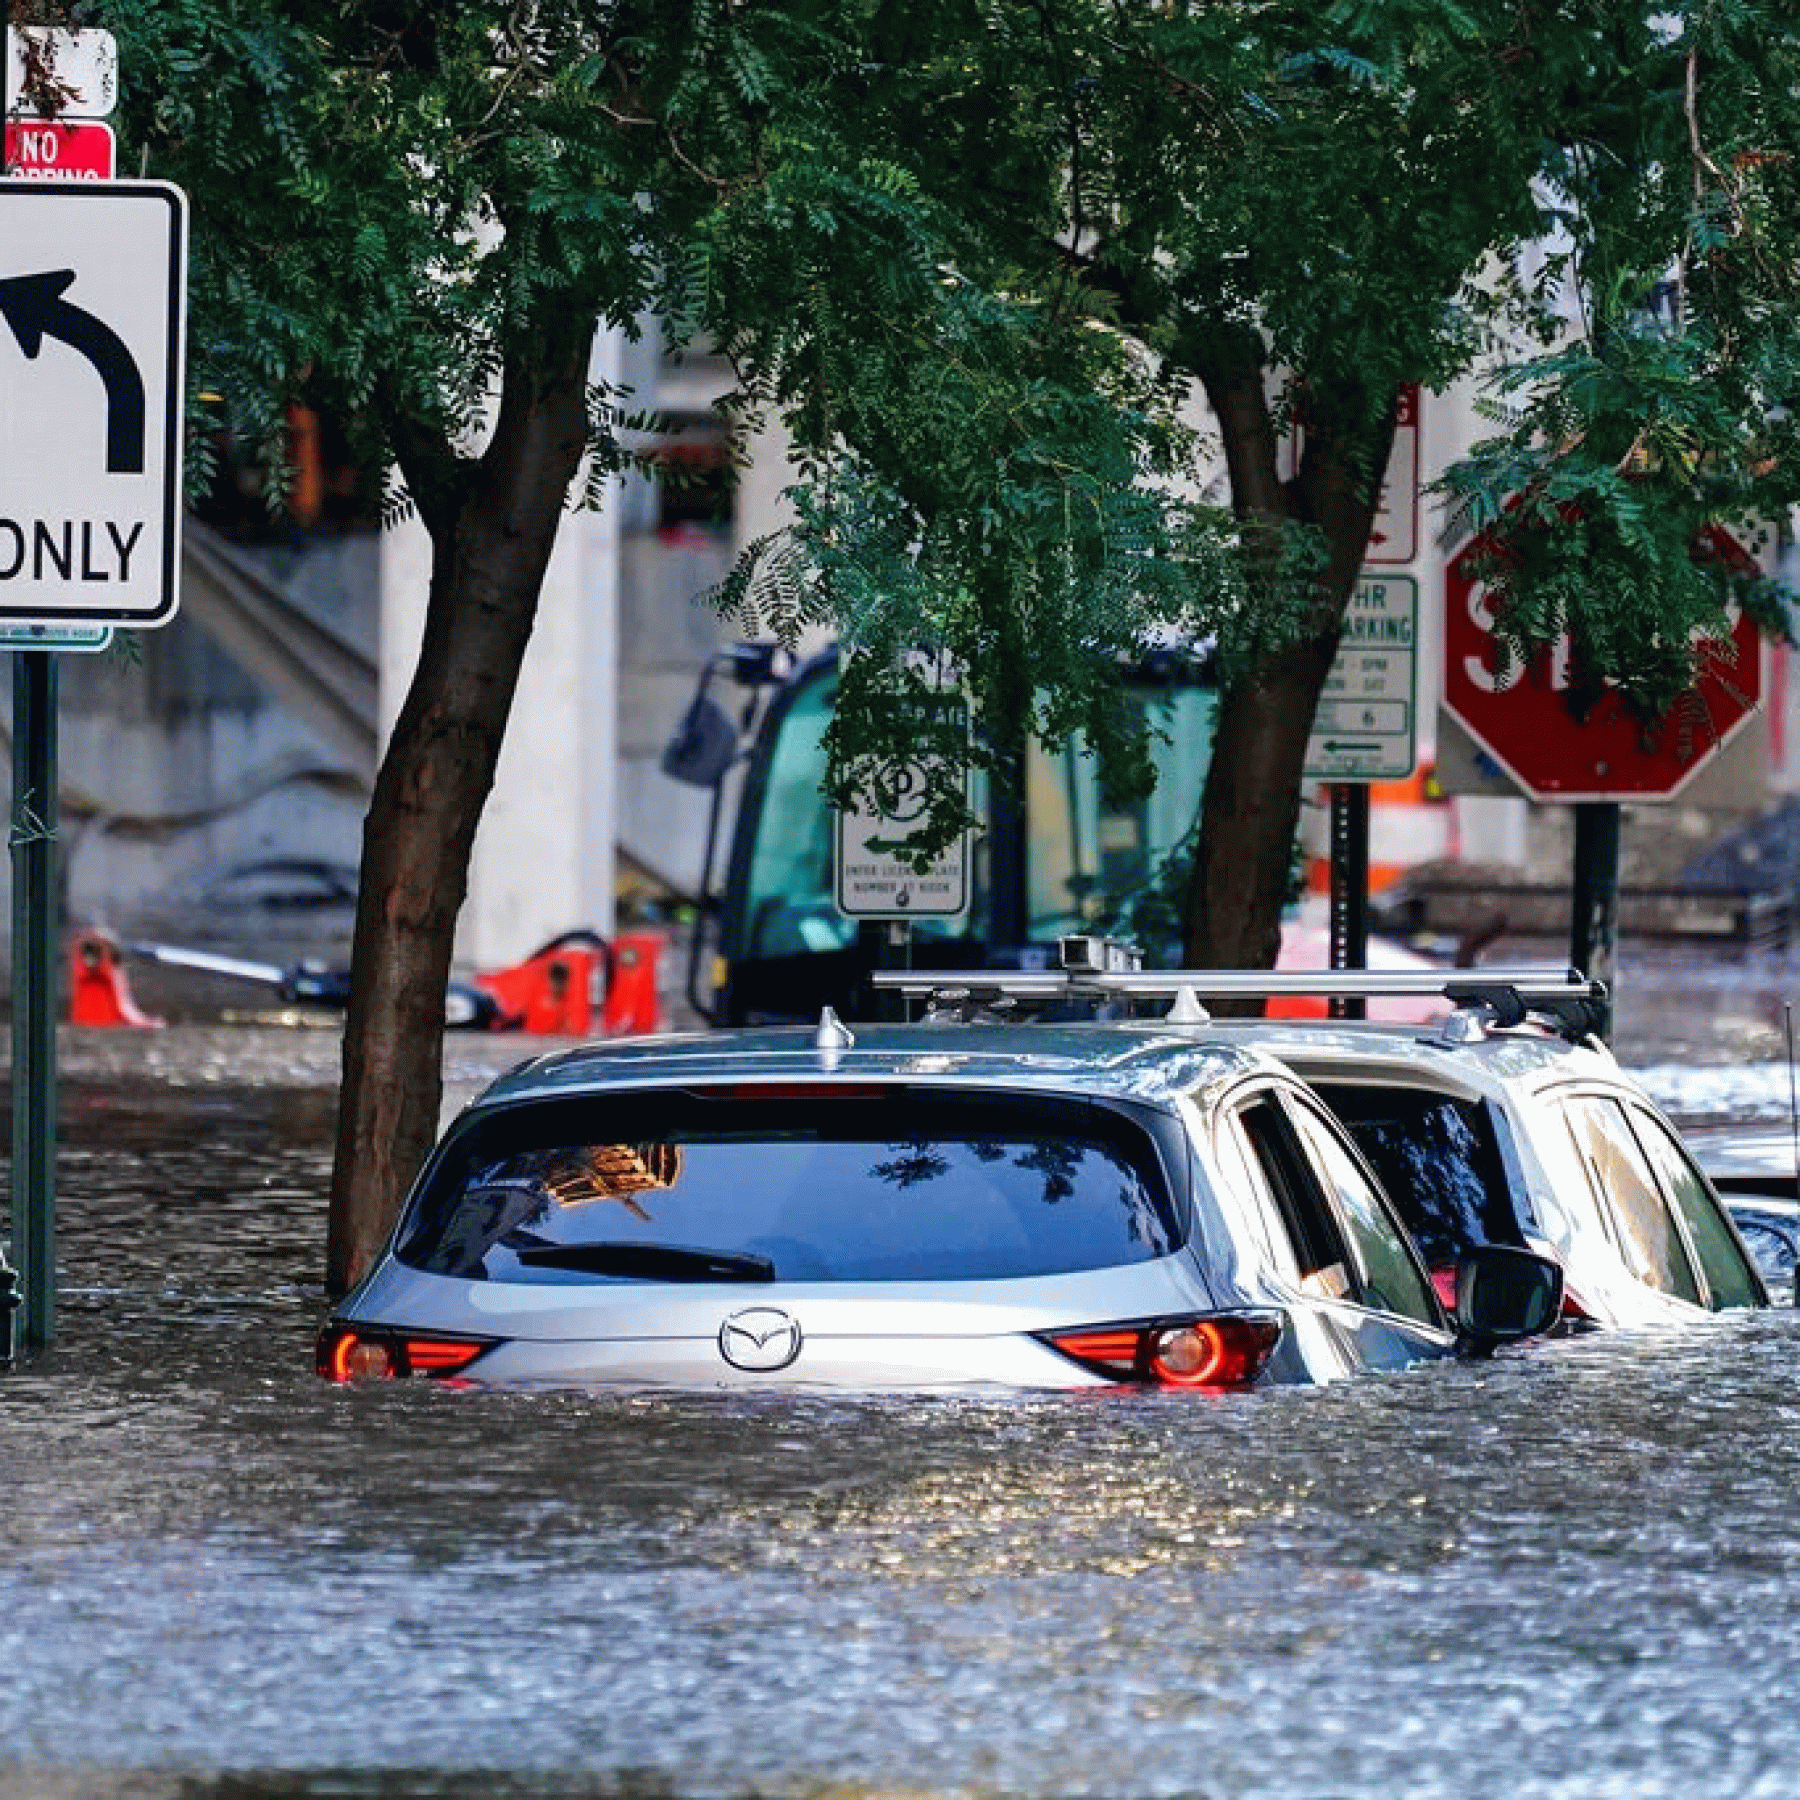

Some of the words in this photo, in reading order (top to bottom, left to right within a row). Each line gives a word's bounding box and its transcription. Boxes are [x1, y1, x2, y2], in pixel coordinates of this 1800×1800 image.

[22, 131, 58, 163] NO
[0, 518, 145, 583] ONLY
[1354, 584, 1386, 609] HR
[1340, 616, 1411, 644] ARKING
[1463, 578, 1742, 693] ST
